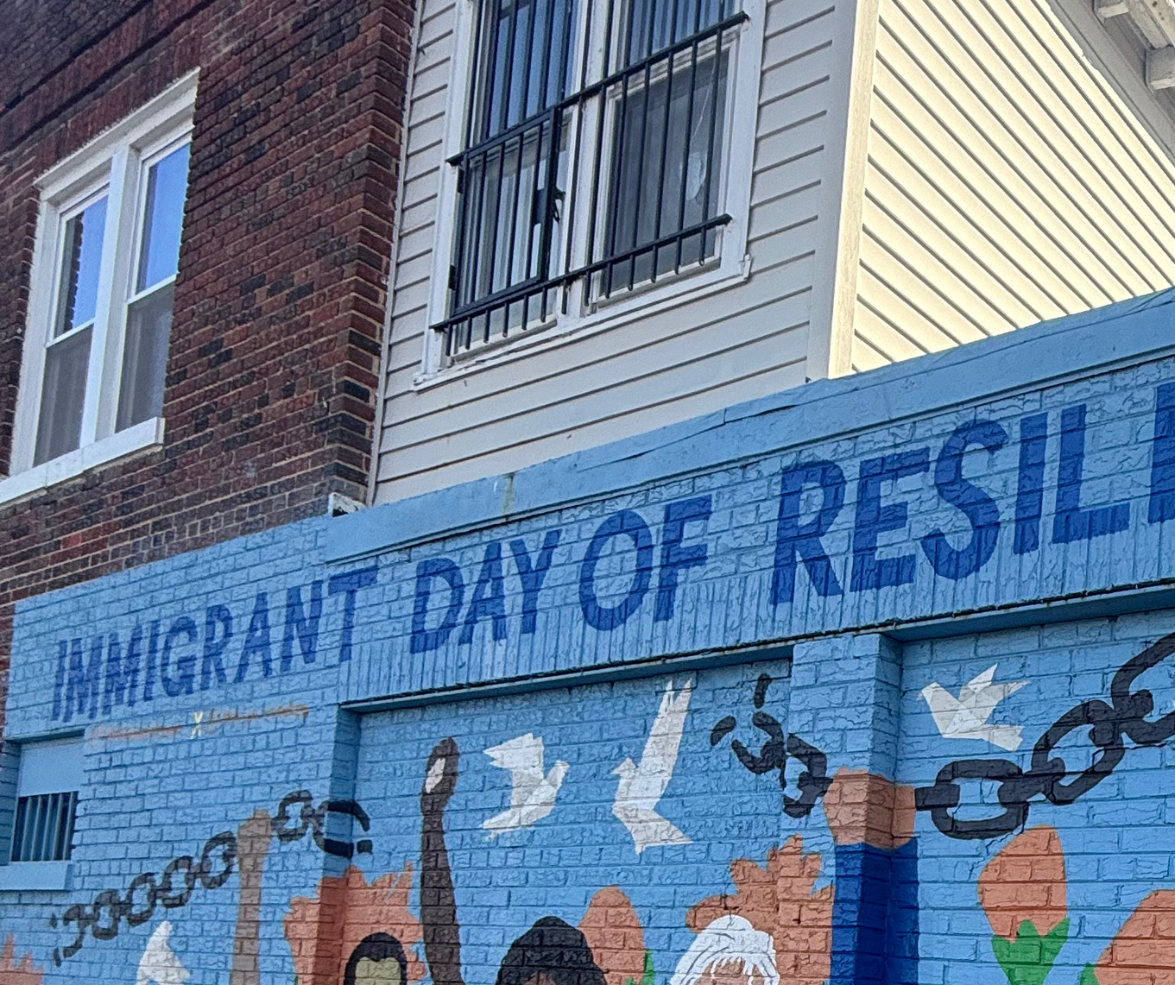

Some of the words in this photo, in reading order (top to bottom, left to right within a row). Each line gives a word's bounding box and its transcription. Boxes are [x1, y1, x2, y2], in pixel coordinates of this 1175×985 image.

[50, 564, 380, 723] IMMIGRANT
[408, 528, 560, 655] DAY
[578, 495, 711, 632] OF
